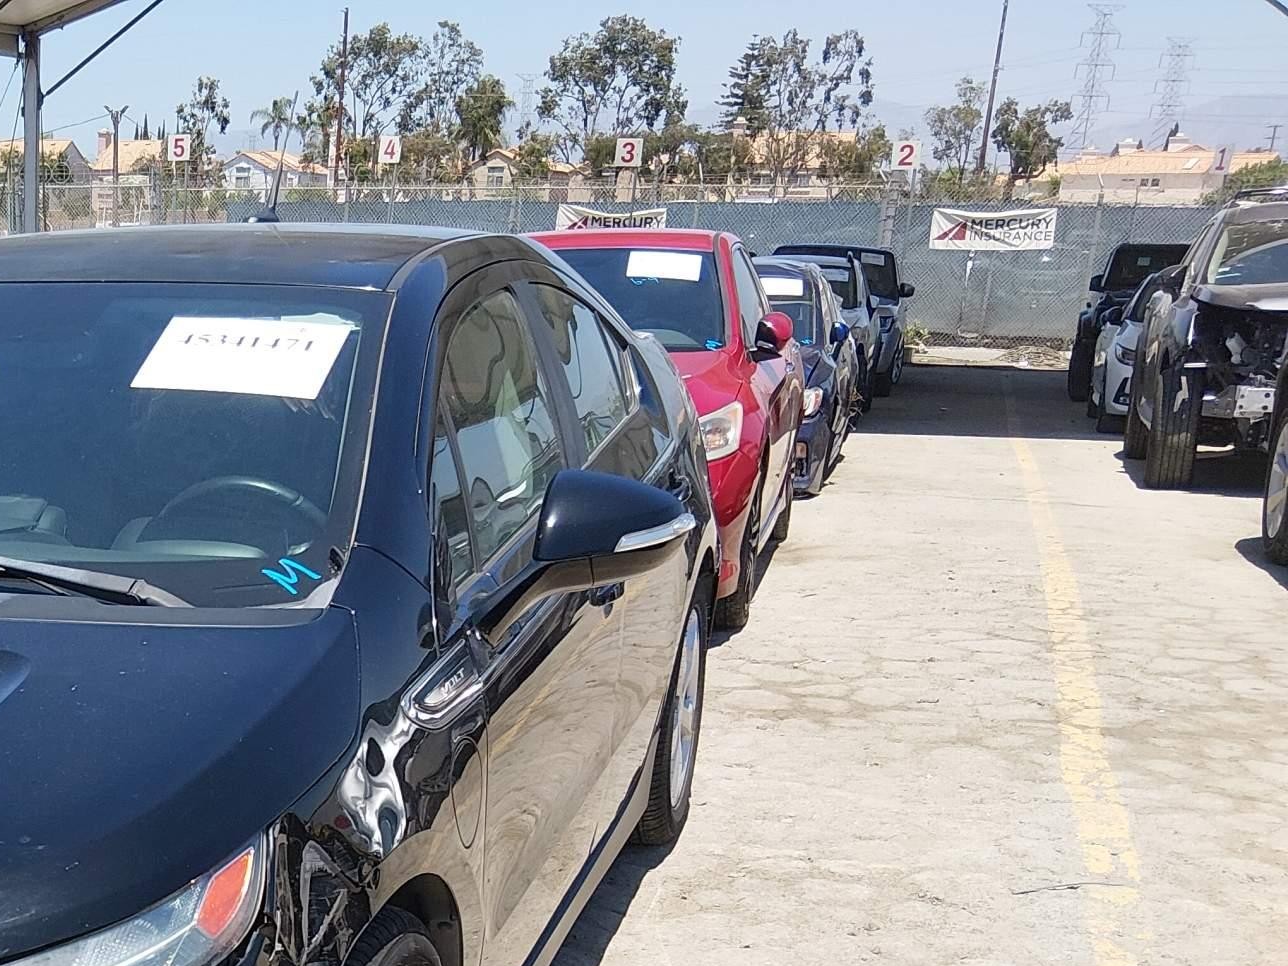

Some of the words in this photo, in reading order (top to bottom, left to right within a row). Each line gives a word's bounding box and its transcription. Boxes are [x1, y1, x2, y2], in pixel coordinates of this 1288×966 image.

[173, 138, 185, 158] 5
[383, 140, 395, 160] 4
[621, 142, 635, 163] 3
[898, 144, 914, 166] 2
[1215, 147, 1227, 171] 1
[591, 215, 663, 228] MERCURY
[970, 217, 1054, 230] MERCURY
[969, 230, 1053, 241] INSURANCE
[440, 667, 465, 696] VOLT
